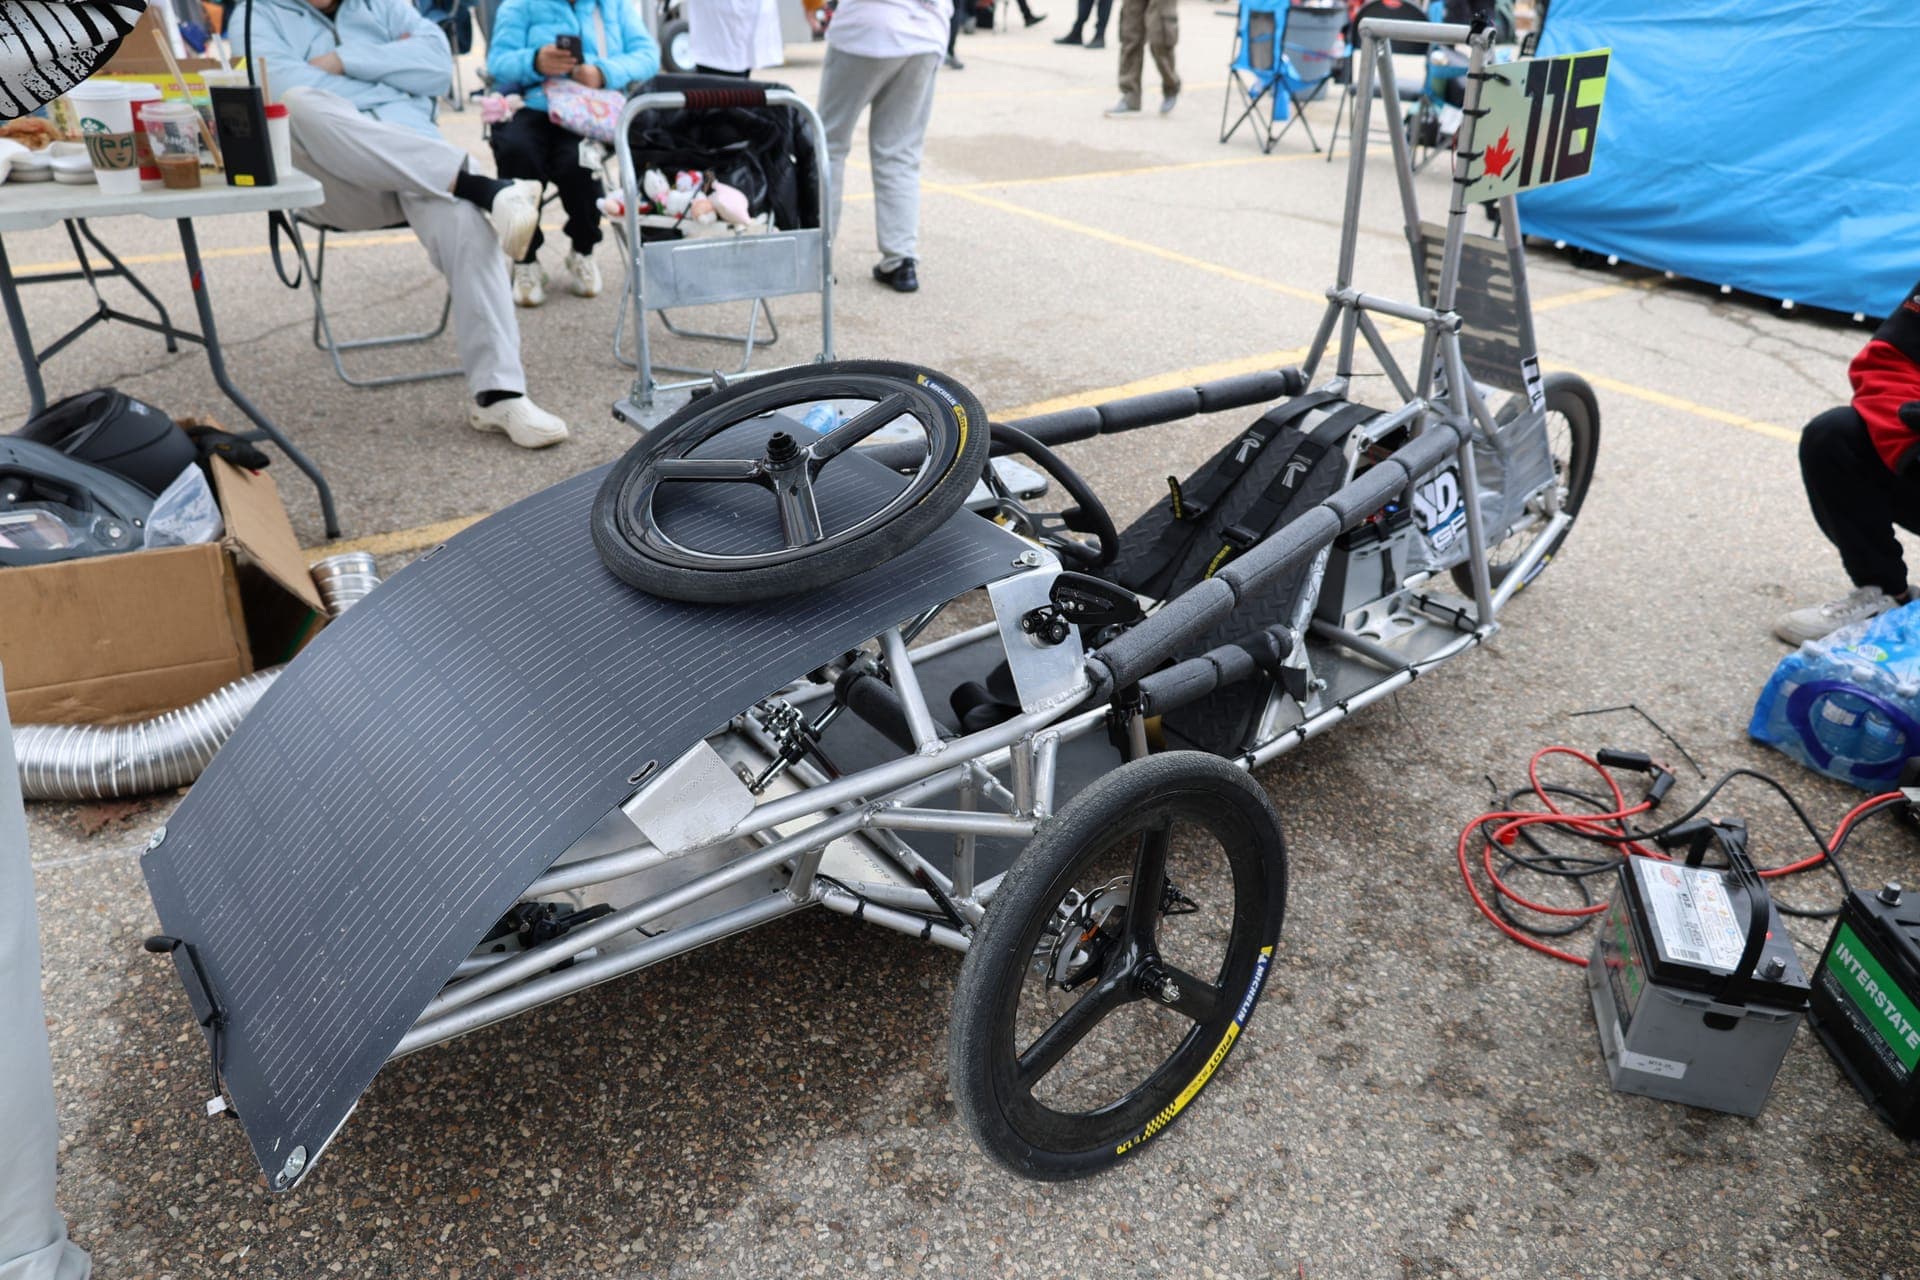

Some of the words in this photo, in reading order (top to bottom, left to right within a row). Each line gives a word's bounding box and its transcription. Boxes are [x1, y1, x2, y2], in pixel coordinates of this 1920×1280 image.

[1518, 54, 1609, 188] 116
[1237, 964, 1265, 1022] MICHELIN
[1835, 942, 1920, 1050] INTERSTATE
[1209, 1034, 1233, 1073] PILOT
